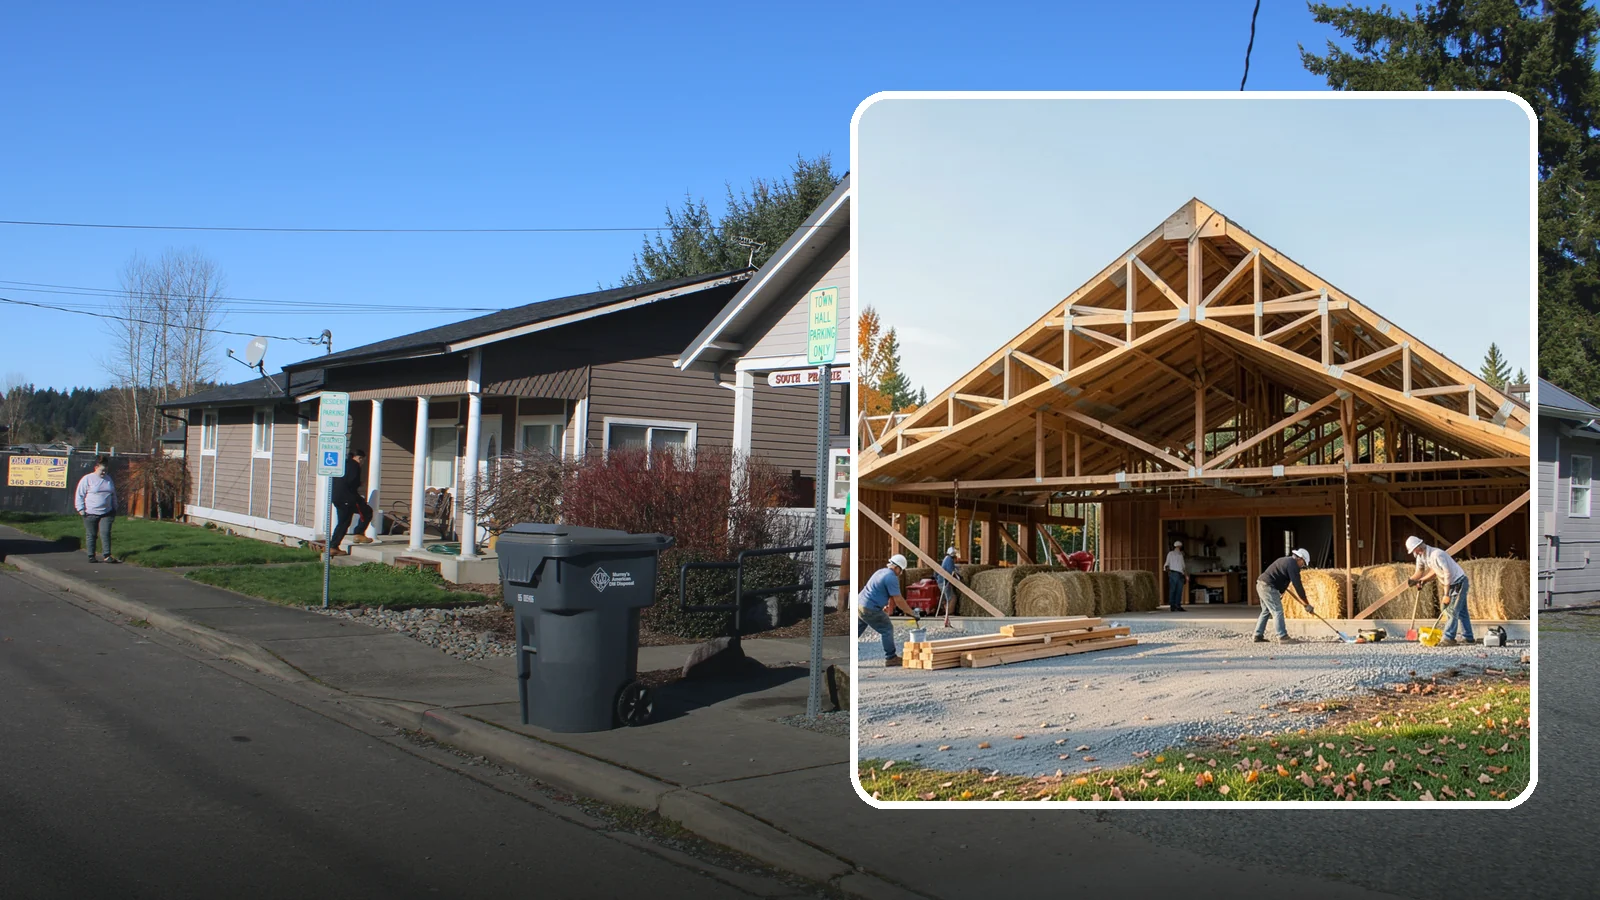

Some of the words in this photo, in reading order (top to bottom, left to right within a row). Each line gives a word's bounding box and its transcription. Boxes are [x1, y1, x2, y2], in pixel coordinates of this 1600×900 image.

[815, 294, 833, 308] TOWN
[814, 311, 831, 324] HALL
[810, 327, 836, 340] PARKING
[813, 344, 831, 357] ONLY
[775, 373, 801, 384] SOUTH
[807, 370, 842, 382] PRIE
[323, 409, 345, 417] PARKING
